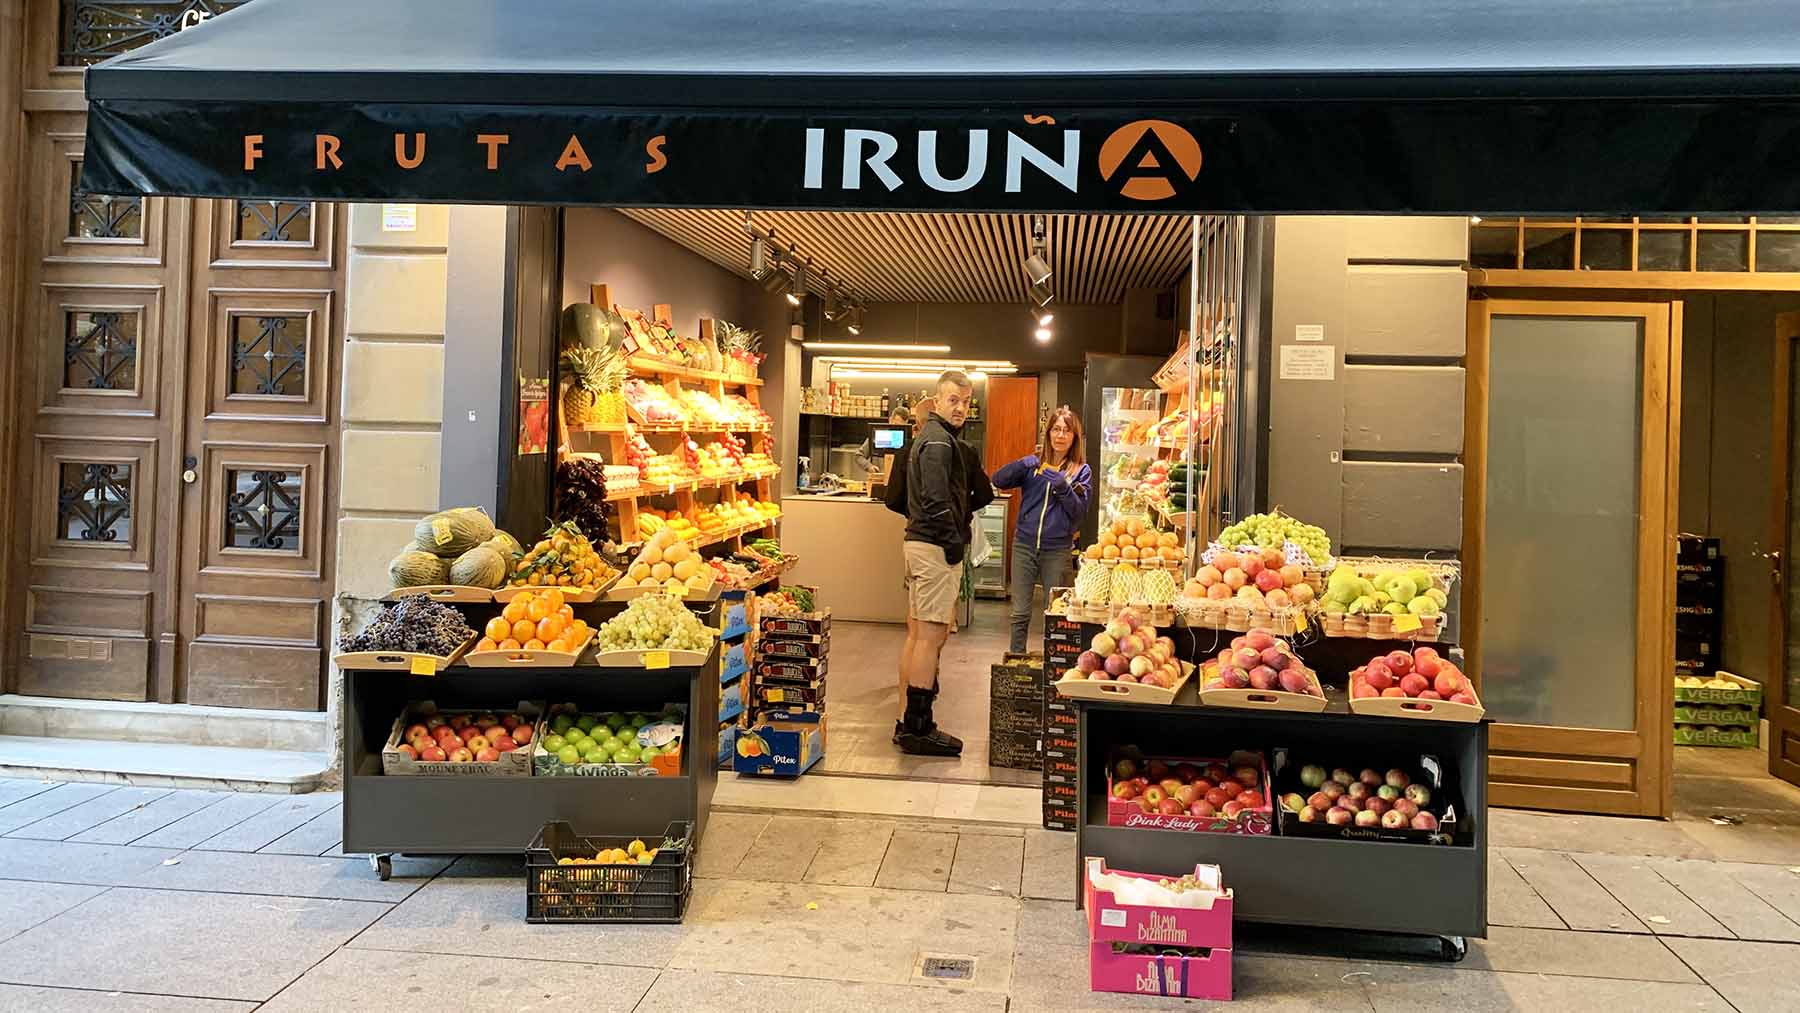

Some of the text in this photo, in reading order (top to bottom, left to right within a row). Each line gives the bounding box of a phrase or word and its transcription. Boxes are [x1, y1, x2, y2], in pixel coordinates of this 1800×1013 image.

[244, 114, 1203, 201] FRUTAS IRUÑA
[1687, 689, 1755, 701] VERGAL
[1685, 709, 1753, 722] VERGAL
[1682, 731, 1750, 743] VERGAL
[773, 755, 796, 764] Pitex
[1126, 814, 1200, 831] Pink Lady
